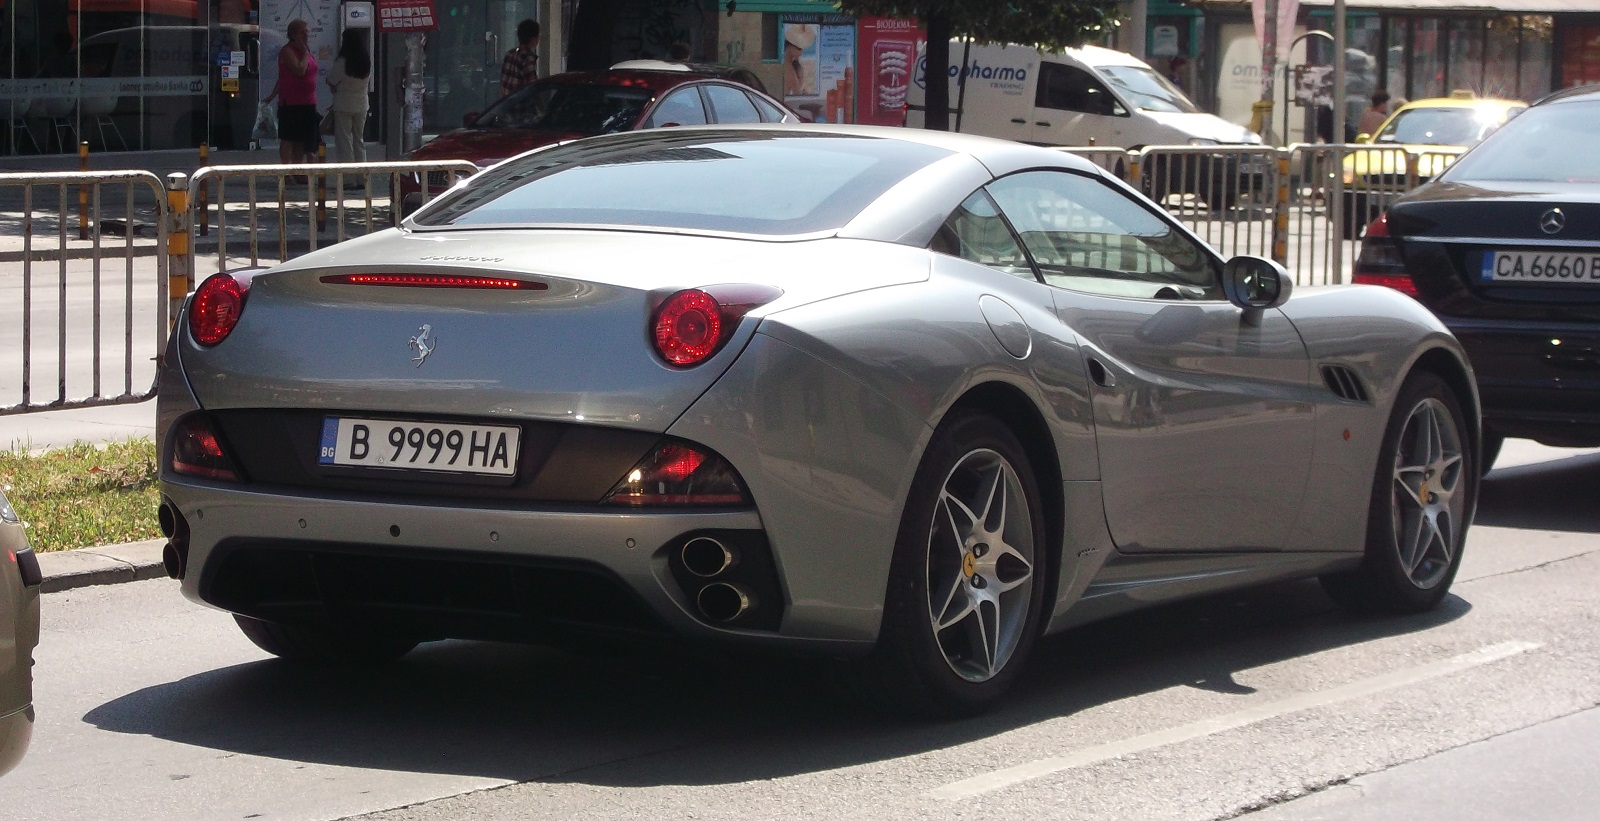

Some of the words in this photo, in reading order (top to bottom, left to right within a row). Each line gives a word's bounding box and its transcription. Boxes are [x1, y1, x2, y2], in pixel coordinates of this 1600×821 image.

[876, 20, 911, 29] BIODERMA
[1496, 255, 1524, 277] CA
[1530, 255, 1586, 278] 6660
[349, 424, 370, 460] B
[321, 447, 335, 458] BG
